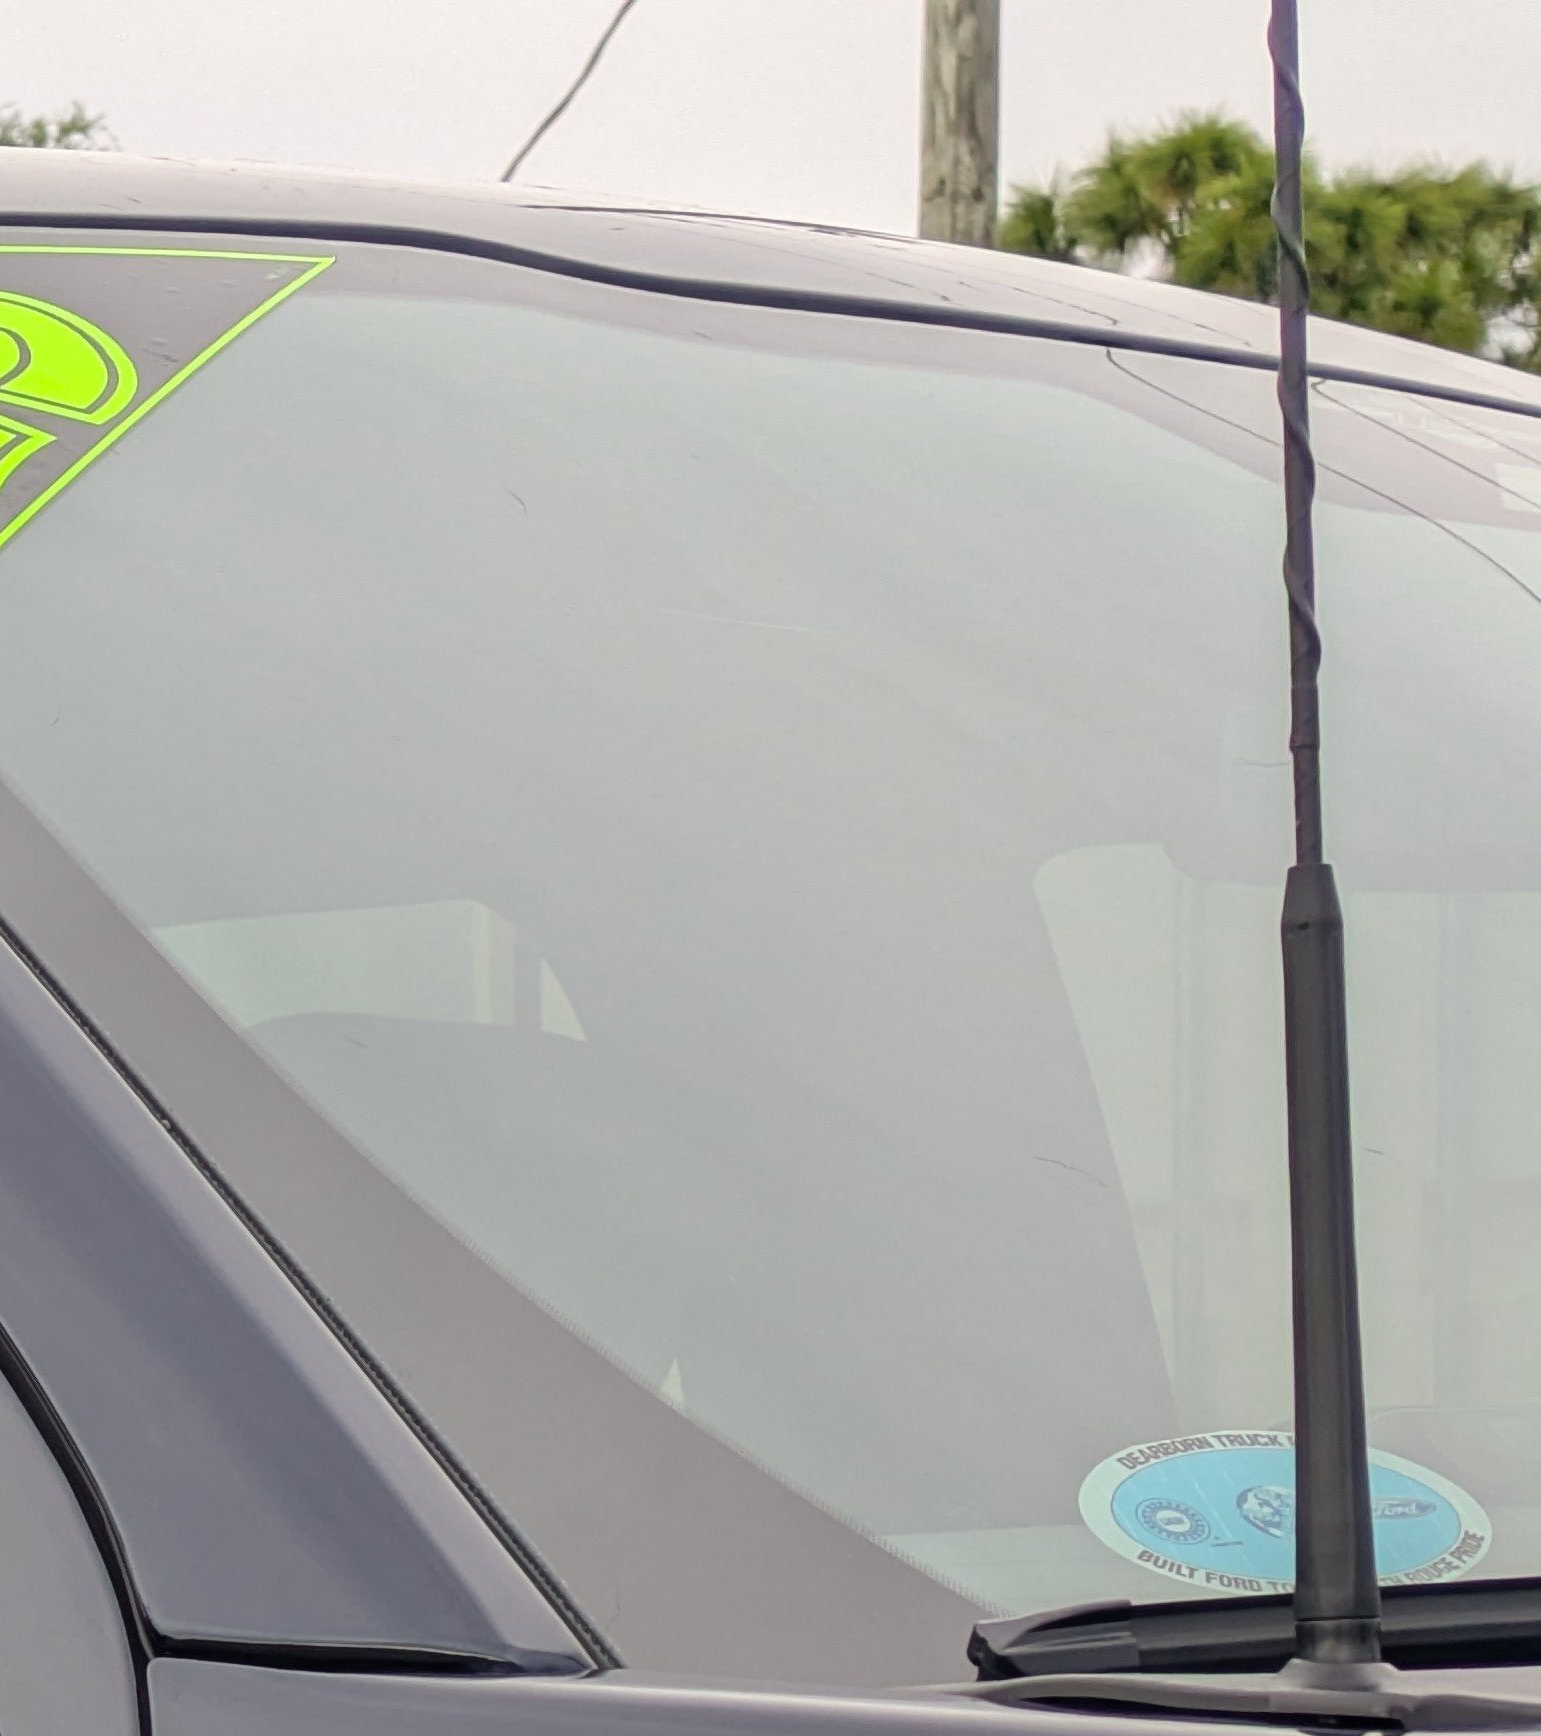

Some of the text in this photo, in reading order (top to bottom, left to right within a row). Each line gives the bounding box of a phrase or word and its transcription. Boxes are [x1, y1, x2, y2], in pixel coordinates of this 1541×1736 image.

[1116, 1434, 1214, 1470] DEARBORN
[1211, 1433, 1284, 1448] TRUCK
[1136, 1549, 1199, 1580] BUILT
[1204, 1570, 1263, 1593] FORD
[1447, 1529, 1485, 1564] PRIDE
